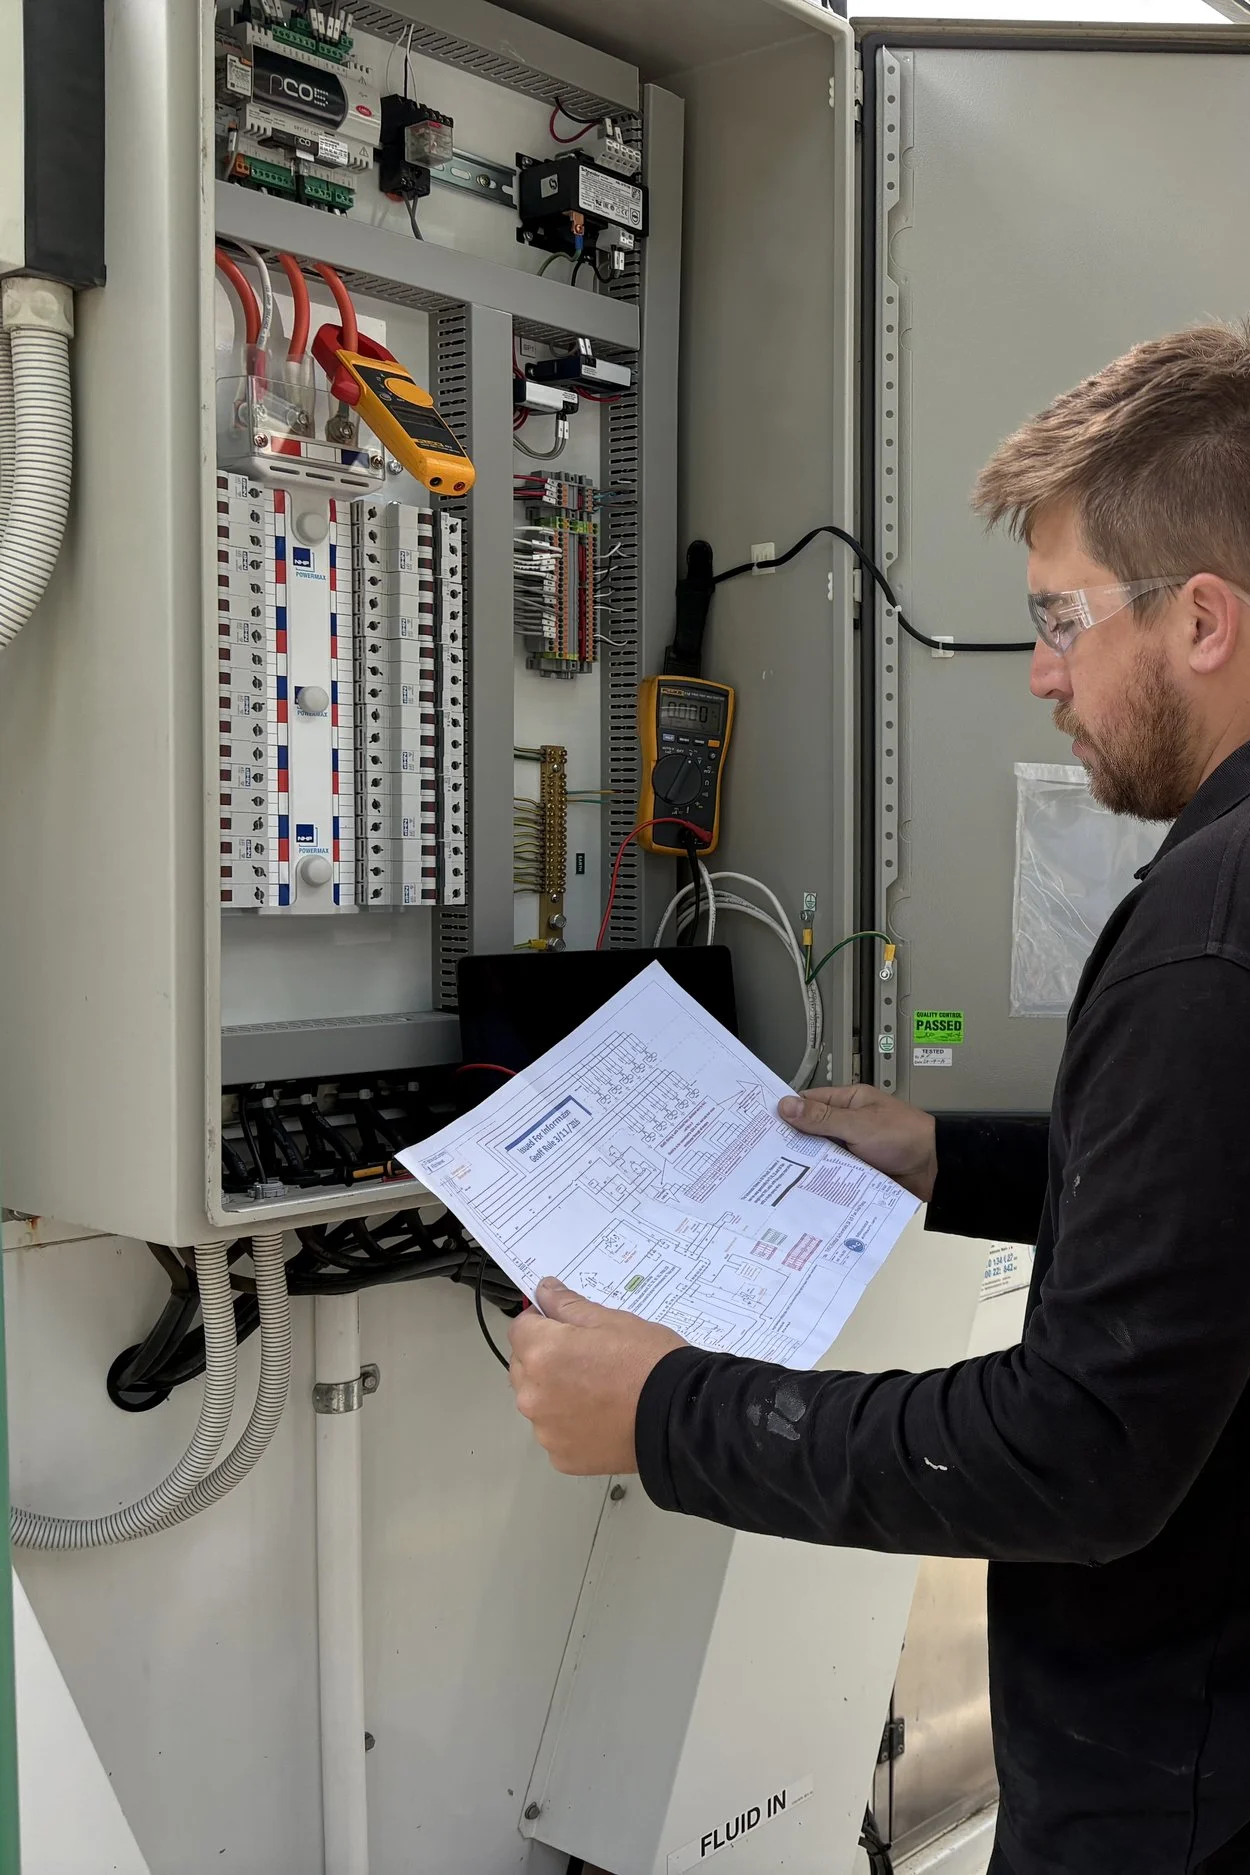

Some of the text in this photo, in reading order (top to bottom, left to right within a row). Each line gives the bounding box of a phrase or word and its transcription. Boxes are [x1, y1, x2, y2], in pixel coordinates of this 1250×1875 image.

[295, 570, 327, 582] POWERMAX
[298, 846, 330, 855] POWERMAX
[916, 1020, 962, 1031] PASSED
[516, 1139, 536, 1155] Issued
[531, 1132, 545, 1143] For
[529, 1147, 546, 1163] Geoff
[543, 1140, 557, 1153] Rule
[700, 1789, 787, 1858] FLUID IN
